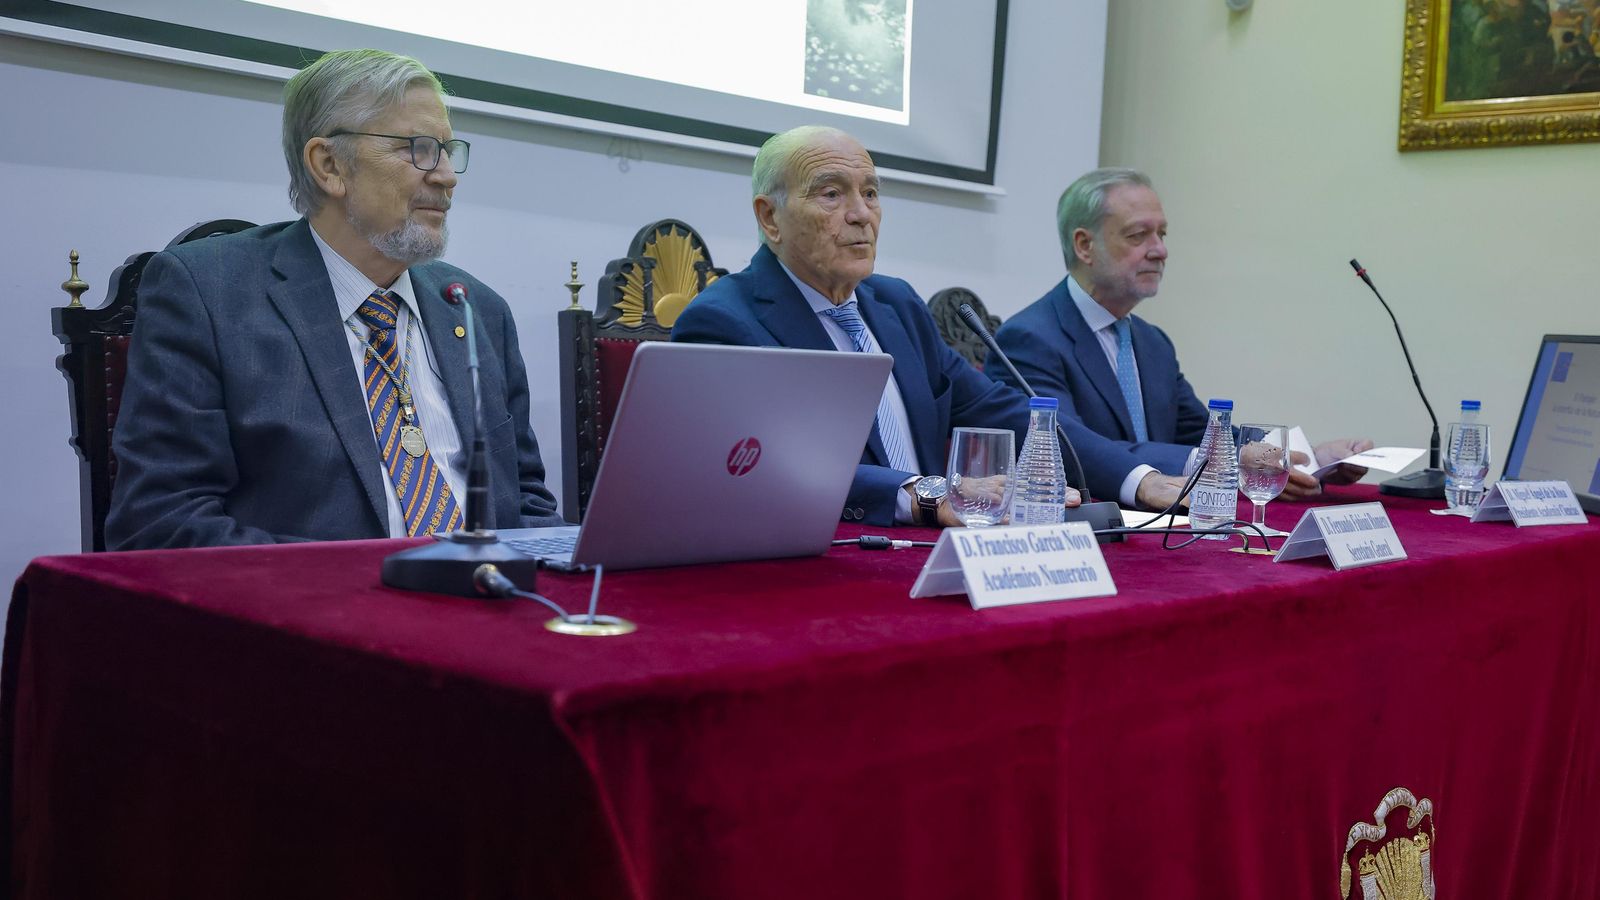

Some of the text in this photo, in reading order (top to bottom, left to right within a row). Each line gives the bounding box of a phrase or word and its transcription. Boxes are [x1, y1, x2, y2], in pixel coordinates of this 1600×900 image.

[728, 438, 760, 477] hp
[1320, 517, 1334, 535] D.
[1326, 516, 1356, 535] Fernando
[959, 529, 1093, 558] D. Francisco García Novo
[1346, 538, 1394, 562] Secretario General
[982, 562, 1098, 591] Académico Numerario
